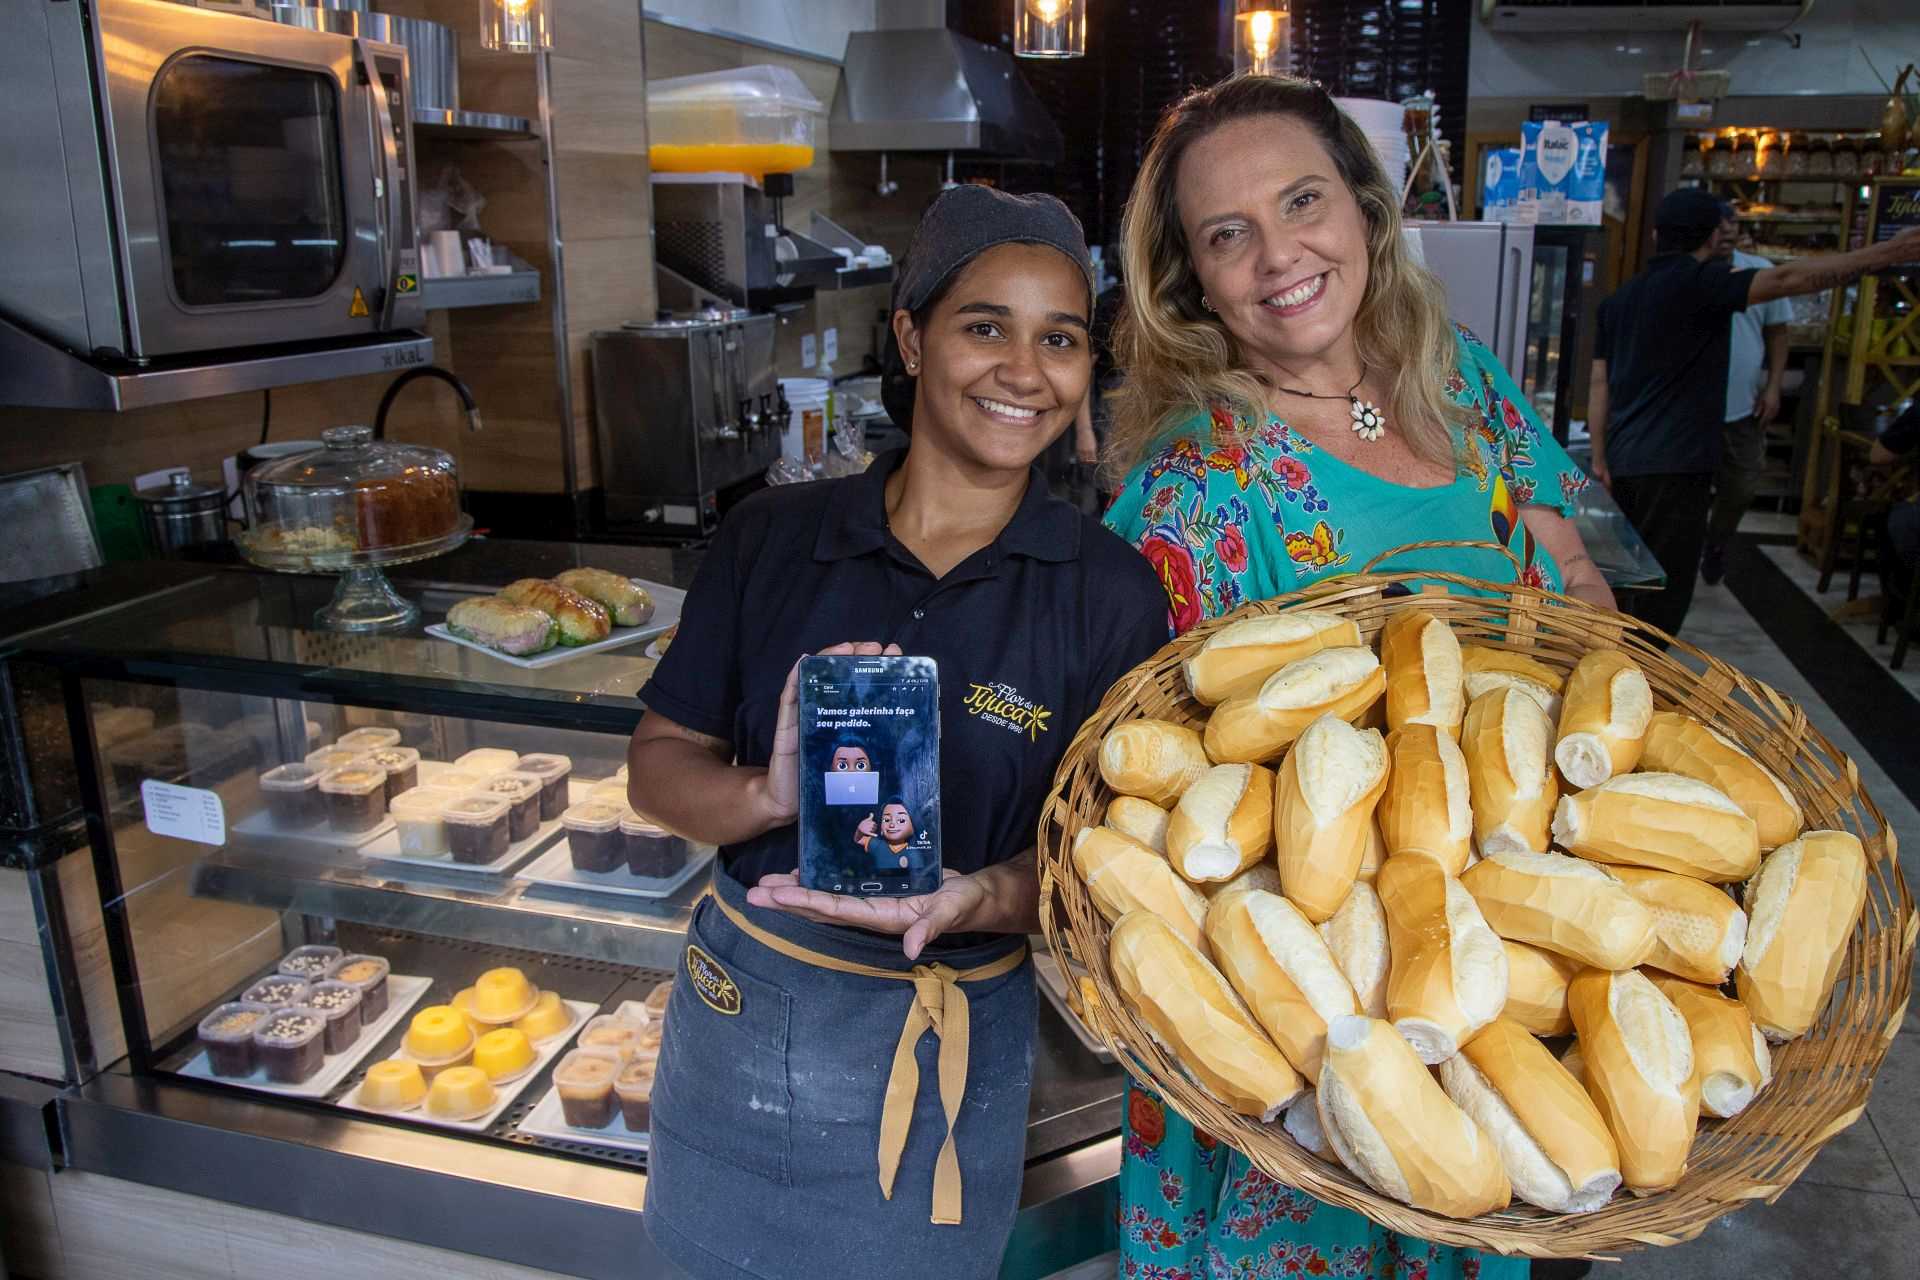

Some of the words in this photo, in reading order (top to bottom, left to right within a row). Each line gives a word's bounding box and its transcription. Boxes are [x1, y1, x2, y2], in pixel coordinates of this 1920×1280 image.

[988, 682, 1025, 706] Flor
[1025, 701, 1034, 710] da
[816, 707, 848, 716] Vamos
[849, 706, 894, 717] galerinha
[895, 706, 915, 717] faça
[816, 720, 833, 728] seu
[834, 719, 872, 729] pedido.
[980, 712, 1009, 728] DESDE
